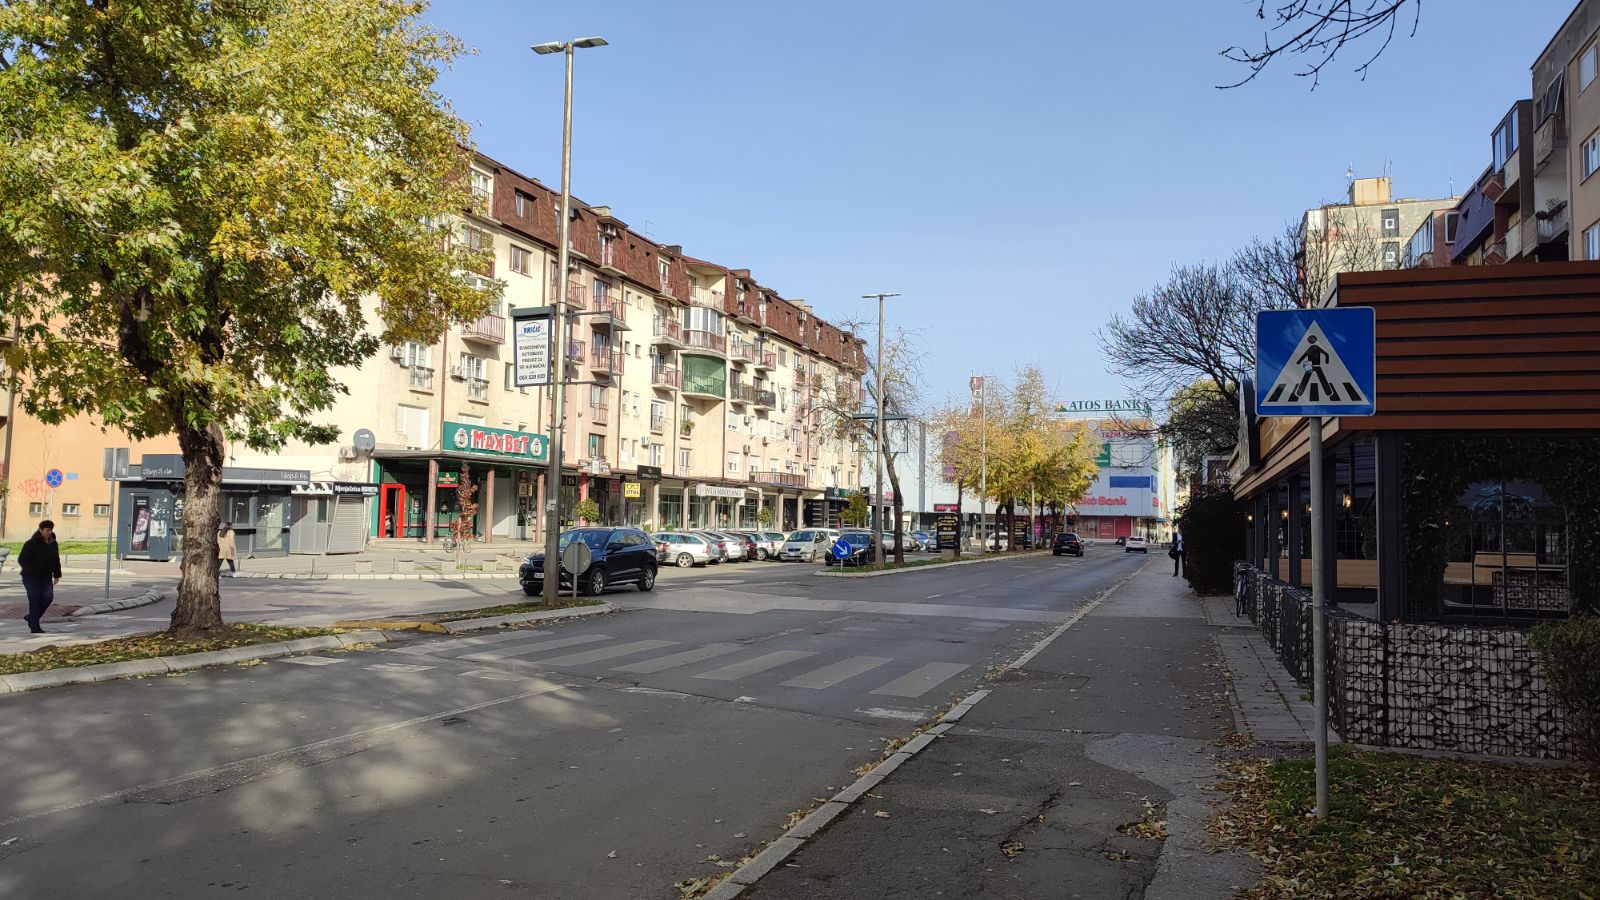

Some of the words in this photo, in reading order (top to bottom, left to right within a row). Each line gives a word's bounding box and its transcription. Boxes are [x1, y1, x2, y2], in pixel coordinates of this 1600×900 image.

[1069, 400, 1101, 410] ATOS
[1105, 400, 1142, 409] BANK
[1098, 496, 1128, 506] Bank
